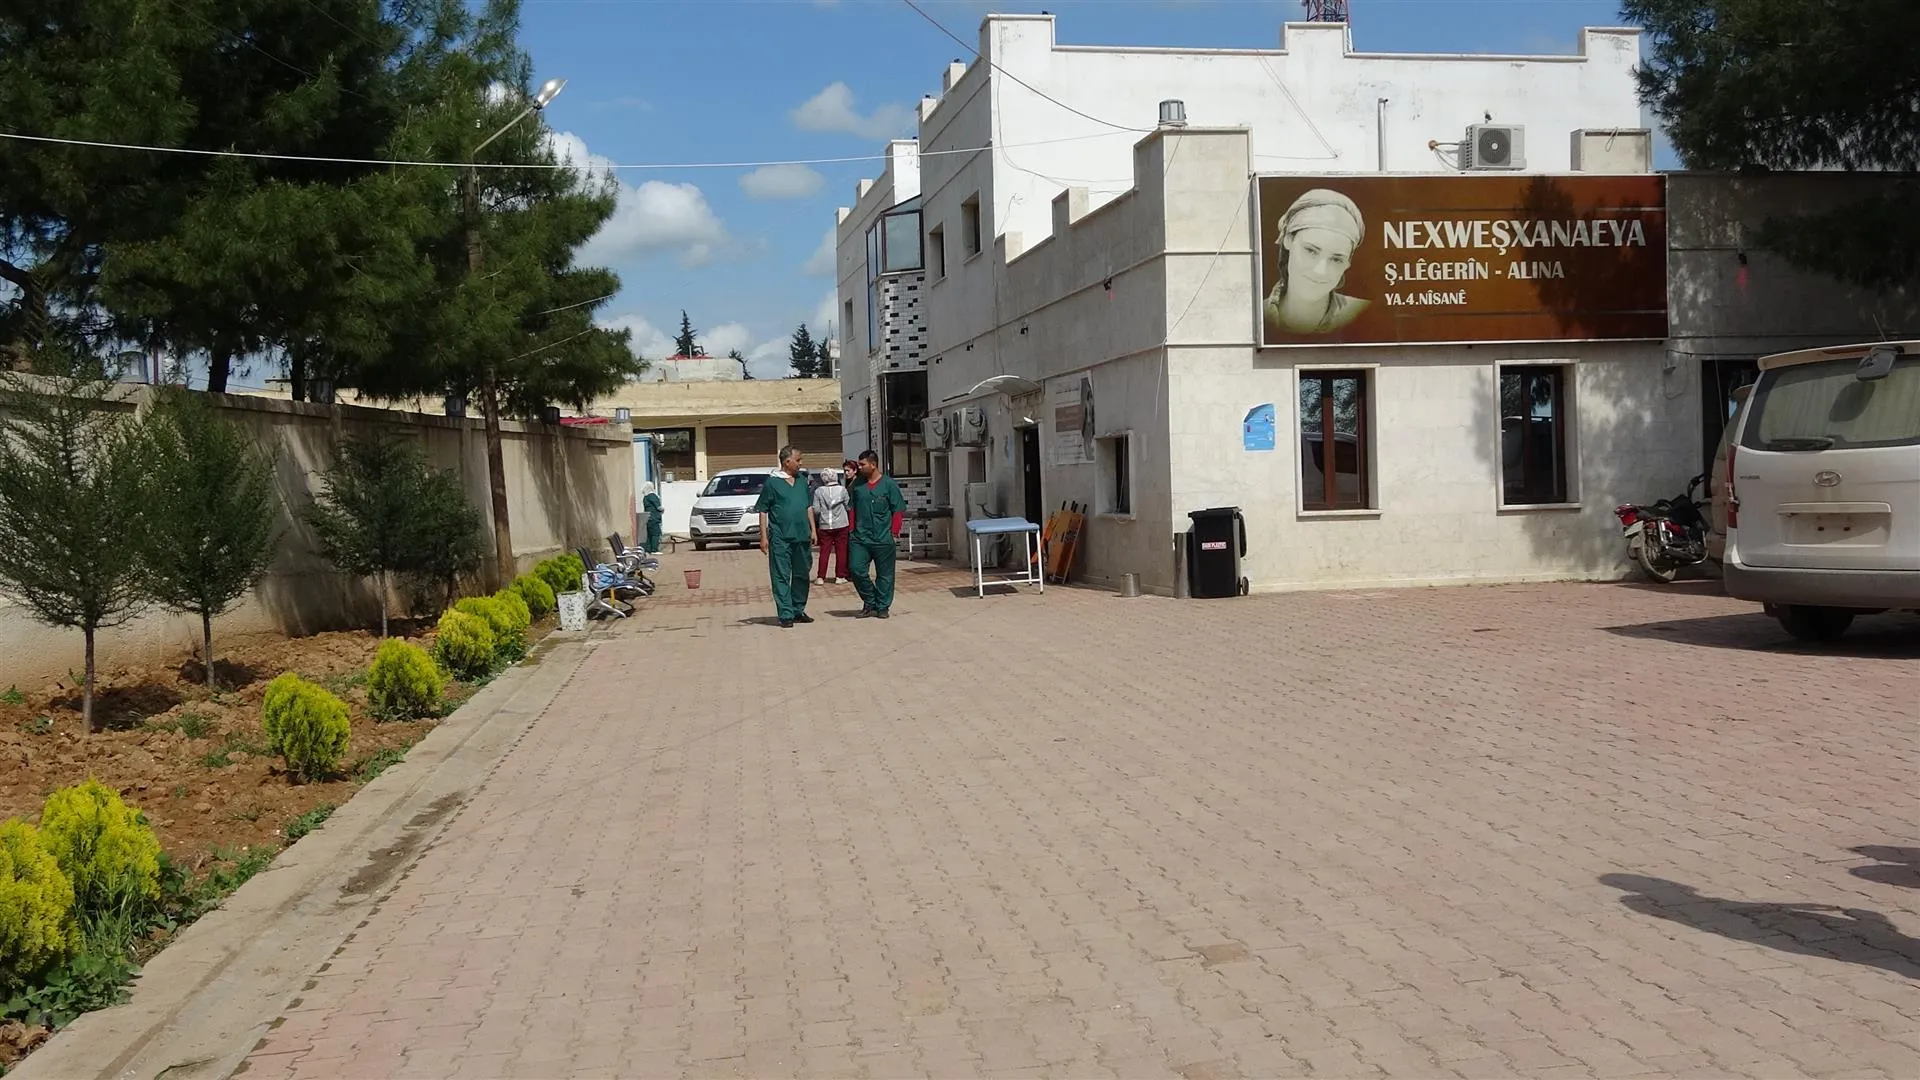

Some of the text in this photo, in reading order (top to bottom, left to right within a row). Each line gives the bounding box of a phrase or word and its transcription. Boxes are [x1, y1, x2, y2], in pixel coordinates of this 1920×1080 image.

[1384, 220, 1646, 255] NEXWEŞXANAEYA
[1385, 258, 1488, 285] Ş.LÊGERÎN
[1508, 261, 1564, 279] ALINA
[1385, 289, 1467, 305] YA.4.NÎSANÊ
